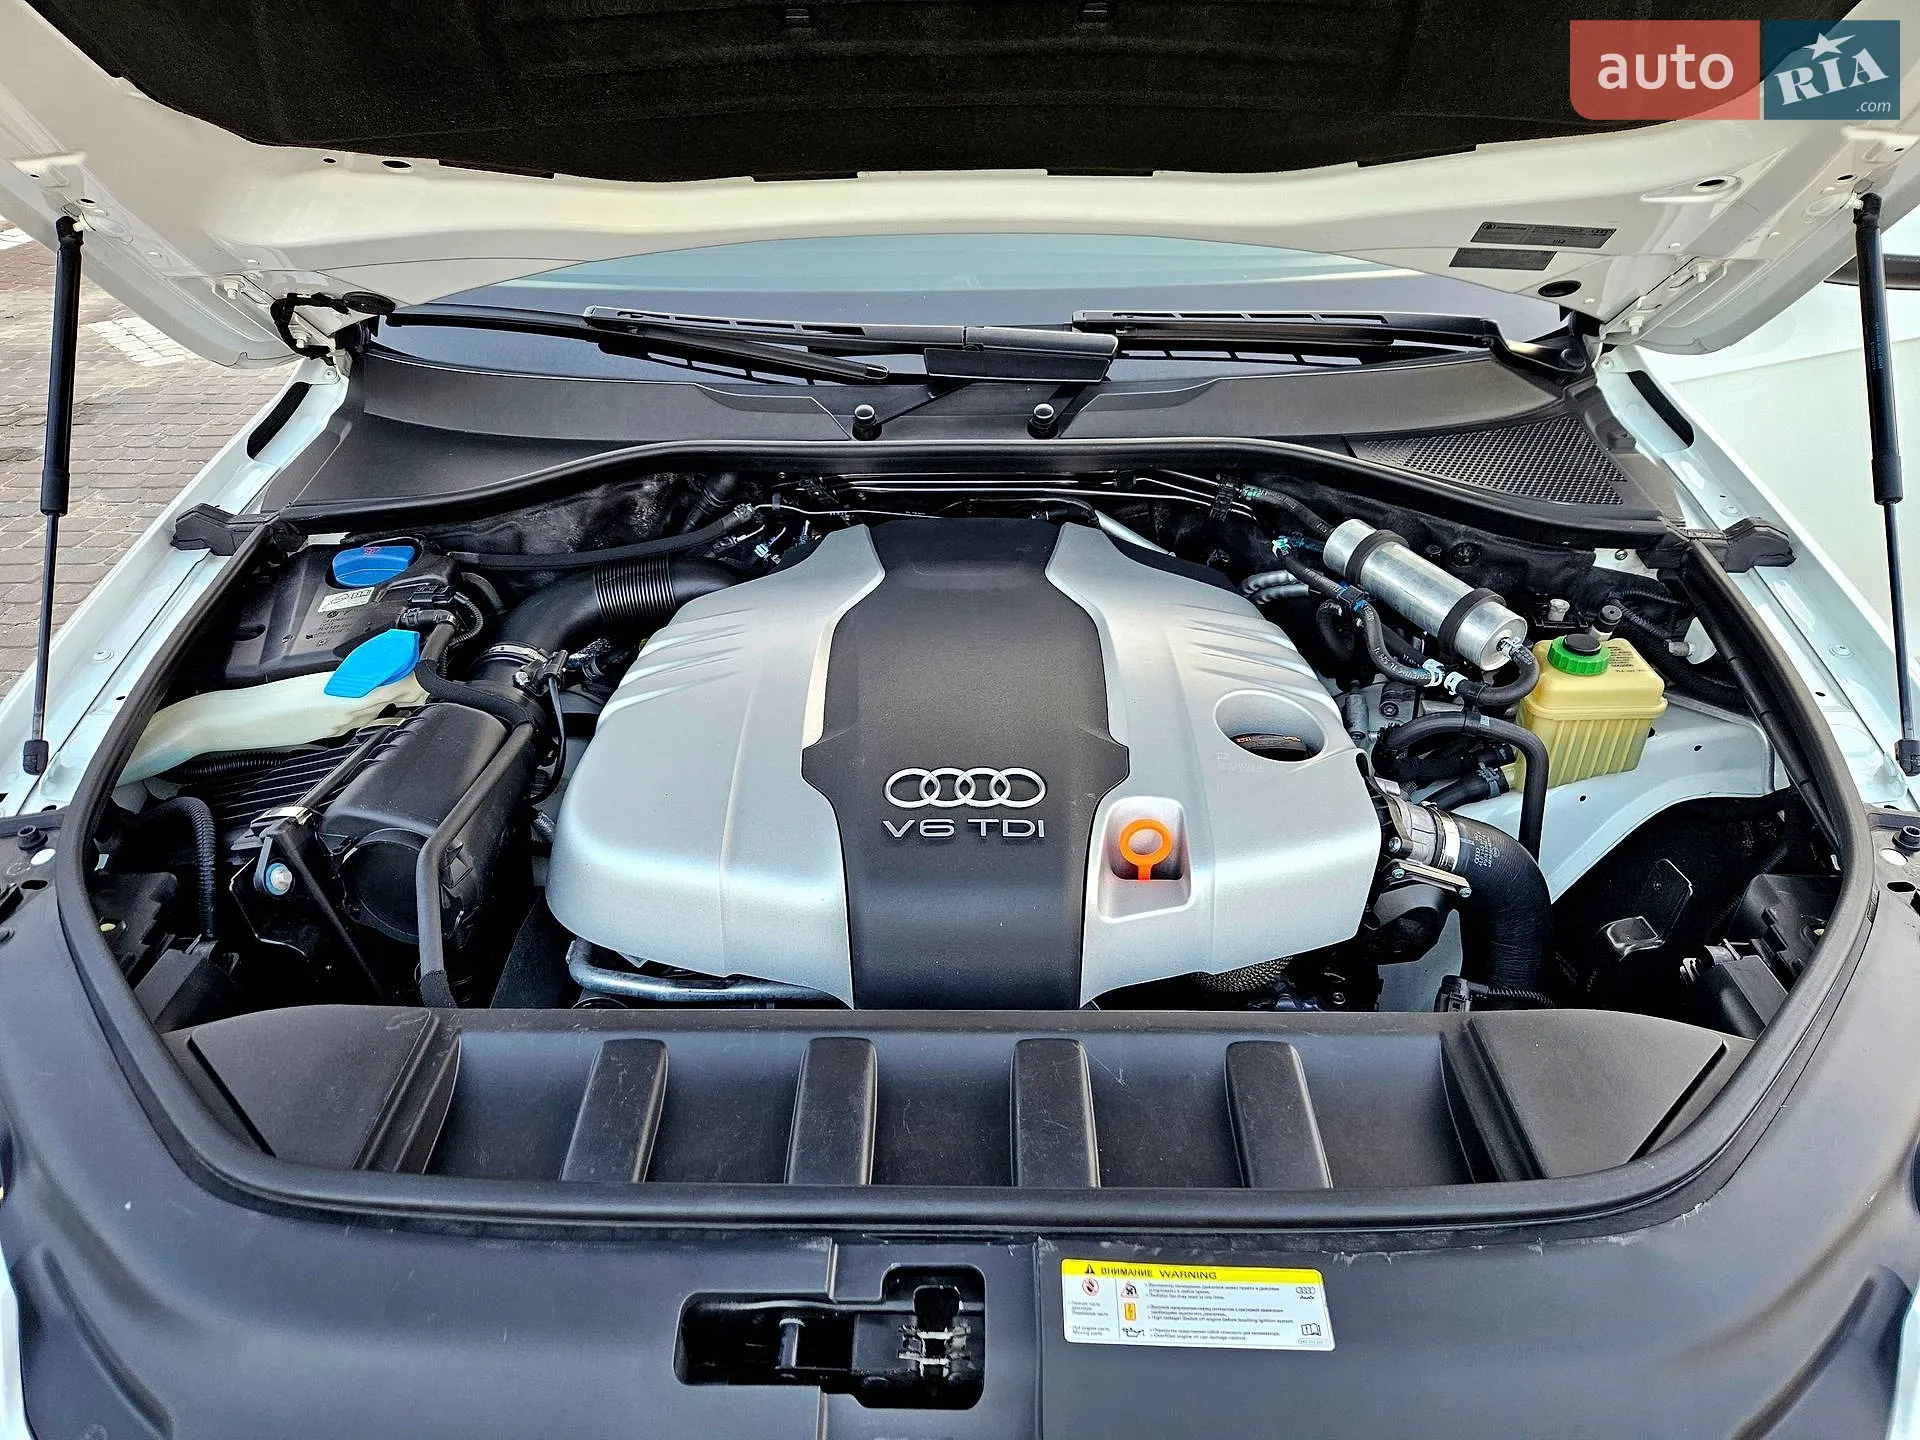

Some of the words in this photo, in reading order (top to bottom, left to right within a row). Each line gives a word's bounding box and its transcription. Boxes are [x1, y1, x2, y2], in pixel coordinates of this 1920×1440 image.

[882, 818, 955, 838] V6
[967, 818, 1045, 838] TDI
[1100, 1265, 1152, 1278] ВНИМАНИЕ
[1159, 1269, 1217, 1280] WARNING
